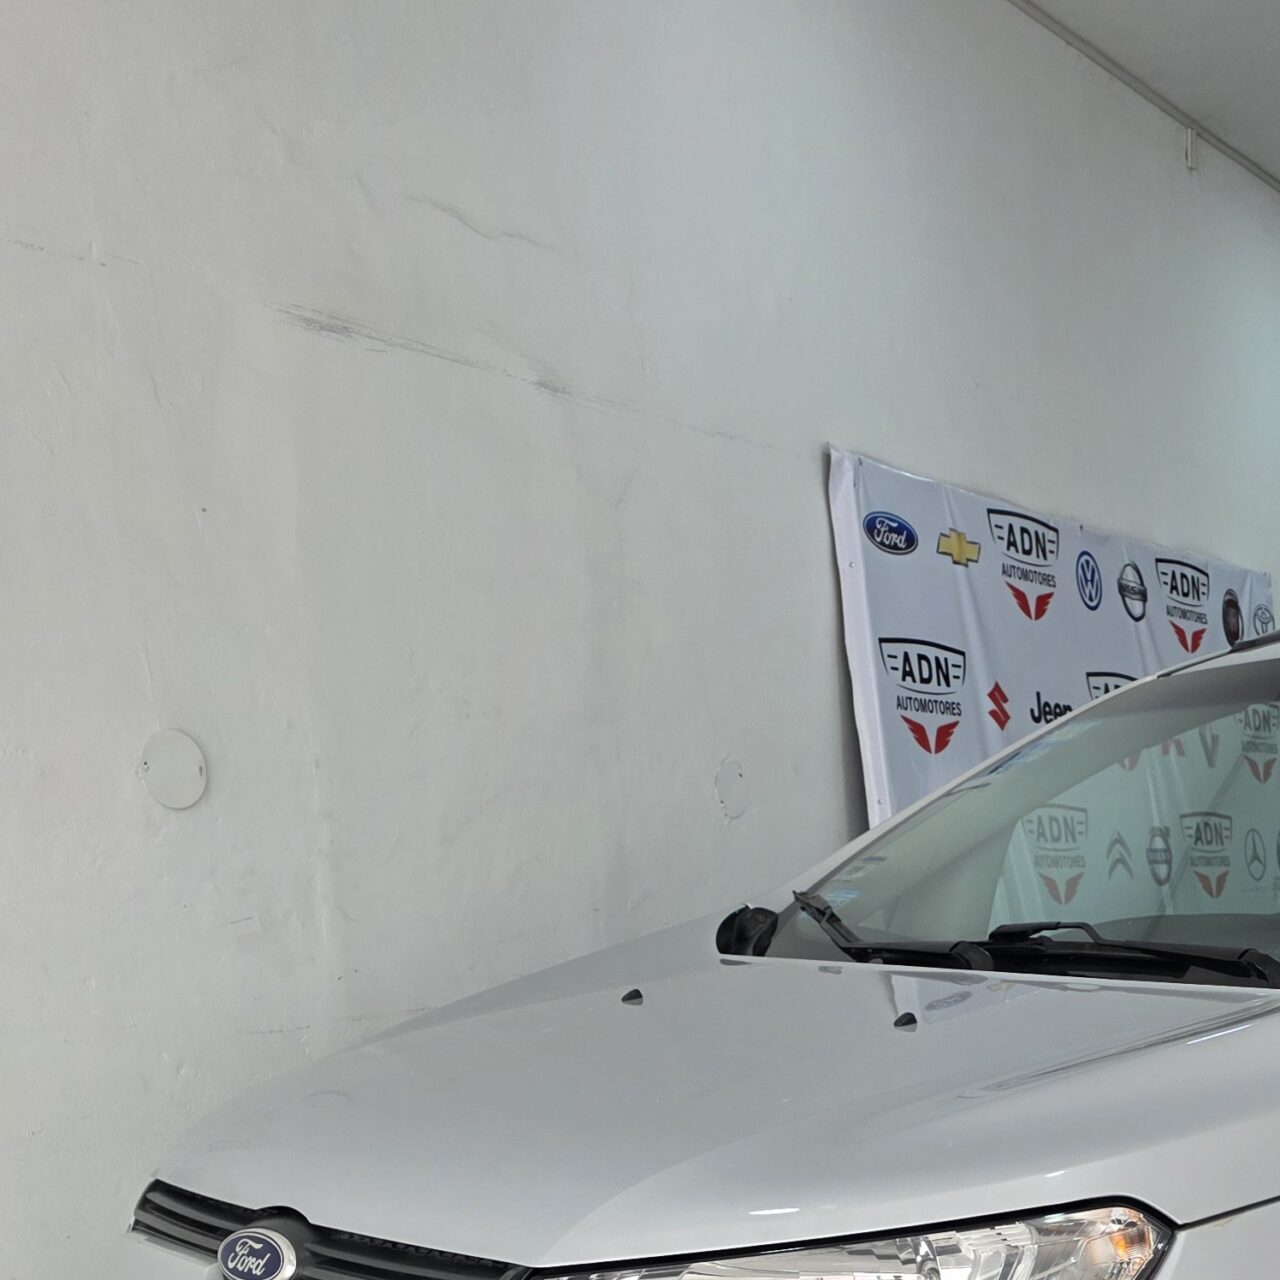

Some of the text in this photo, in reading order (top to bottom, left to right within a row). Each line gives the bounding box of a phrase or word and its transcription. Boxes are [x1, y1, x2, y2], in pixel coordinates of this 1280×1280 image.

[873, 516, 908, 549] Ford
[1006, 522, 1048, 561] ADN
[1001, 562, 1057, 588] AUTOMOTORES
[1169, 569, 1201, 602] ADN
[901, 651, 951, 688] ADN
[896, 695, 962, 717] AUTOMOTORES
[1243, 708, 1272, 734] ADN
[1036, 814, 1077, 843] ADN
[1194, 821, 1225, 846] ADN
[227, 1238, 271, 1276] Ford
